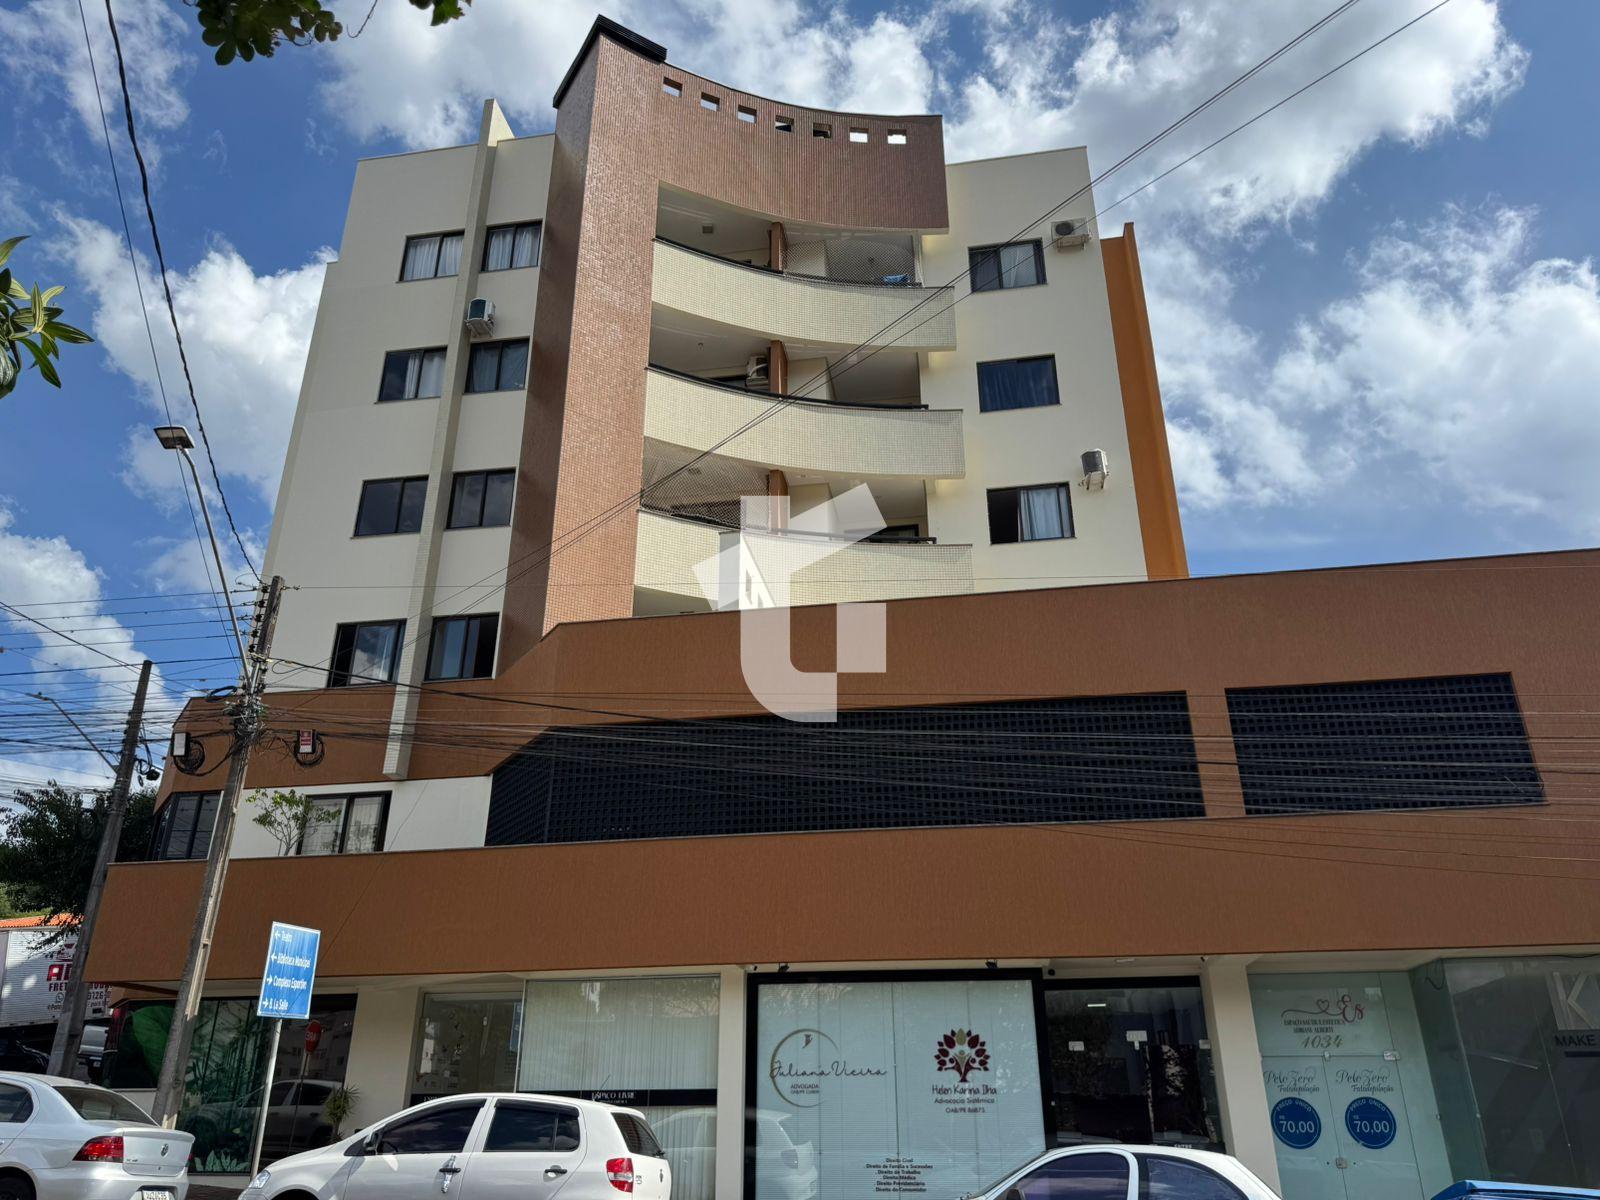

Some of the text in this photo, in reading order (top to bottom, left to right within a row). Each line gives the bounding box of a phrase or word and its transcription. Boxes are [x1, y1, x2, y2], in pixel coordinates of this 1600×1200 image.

[277, 952, 311, 969] Biblioteca Municipal
[273, 976, 291, 989] Complexo
[1302, 1035, 1343, 1048] 1034
[1554, 1034, 1596, 1046] MAKE
[769, 1060, 887, 1078] Juliana Vieira
[1263, 1070, 1288, 1084] Pelo
[1335, 1069, 1362, 1084] Pelo
[931, 1083, 952, 1095] Helen
[953, 1083, 980, 1095] Karina
[1279, 1120, 1315, 1134] 70,00
[1353, 1120, 1390, 1135] 70,00
